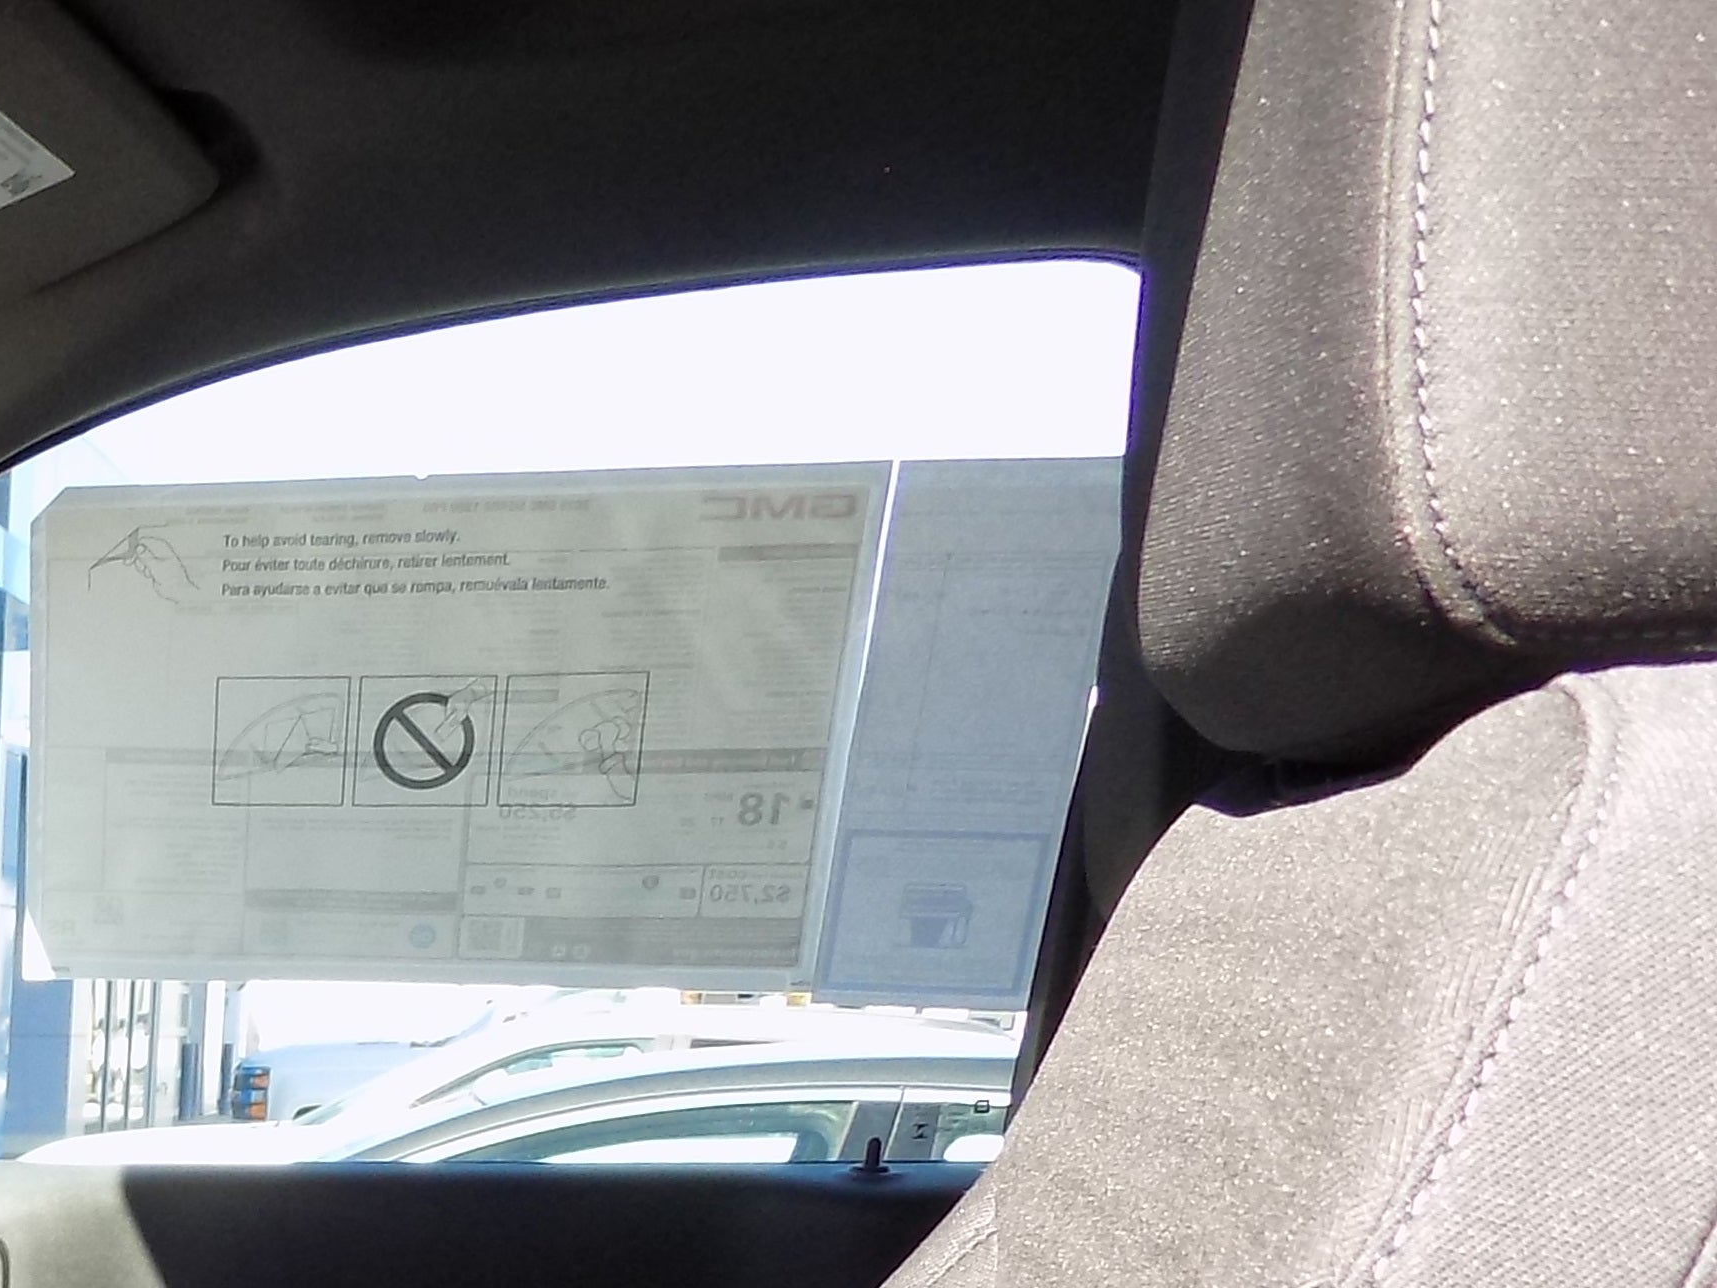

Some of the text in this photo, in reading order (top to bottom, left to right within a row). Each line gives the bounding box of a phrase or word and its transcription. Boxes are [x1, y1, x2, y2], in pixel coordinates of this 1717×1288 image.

[223, 528, 461, 549] To help avoid tearing, remove slowly.
[222, 558, 251, 572] Pour
[293, 557, 325, 571] toute
[397, 554, 438, 569] retirer
[221, 583, 250, 597] Para
[253, 581, 310, 598] ayudarse
[313, 586, 321, 596] a
[324, 581, 361, 595] evitar
[363, 583, 388, 597] que
[391, 583, 406, 595] se
